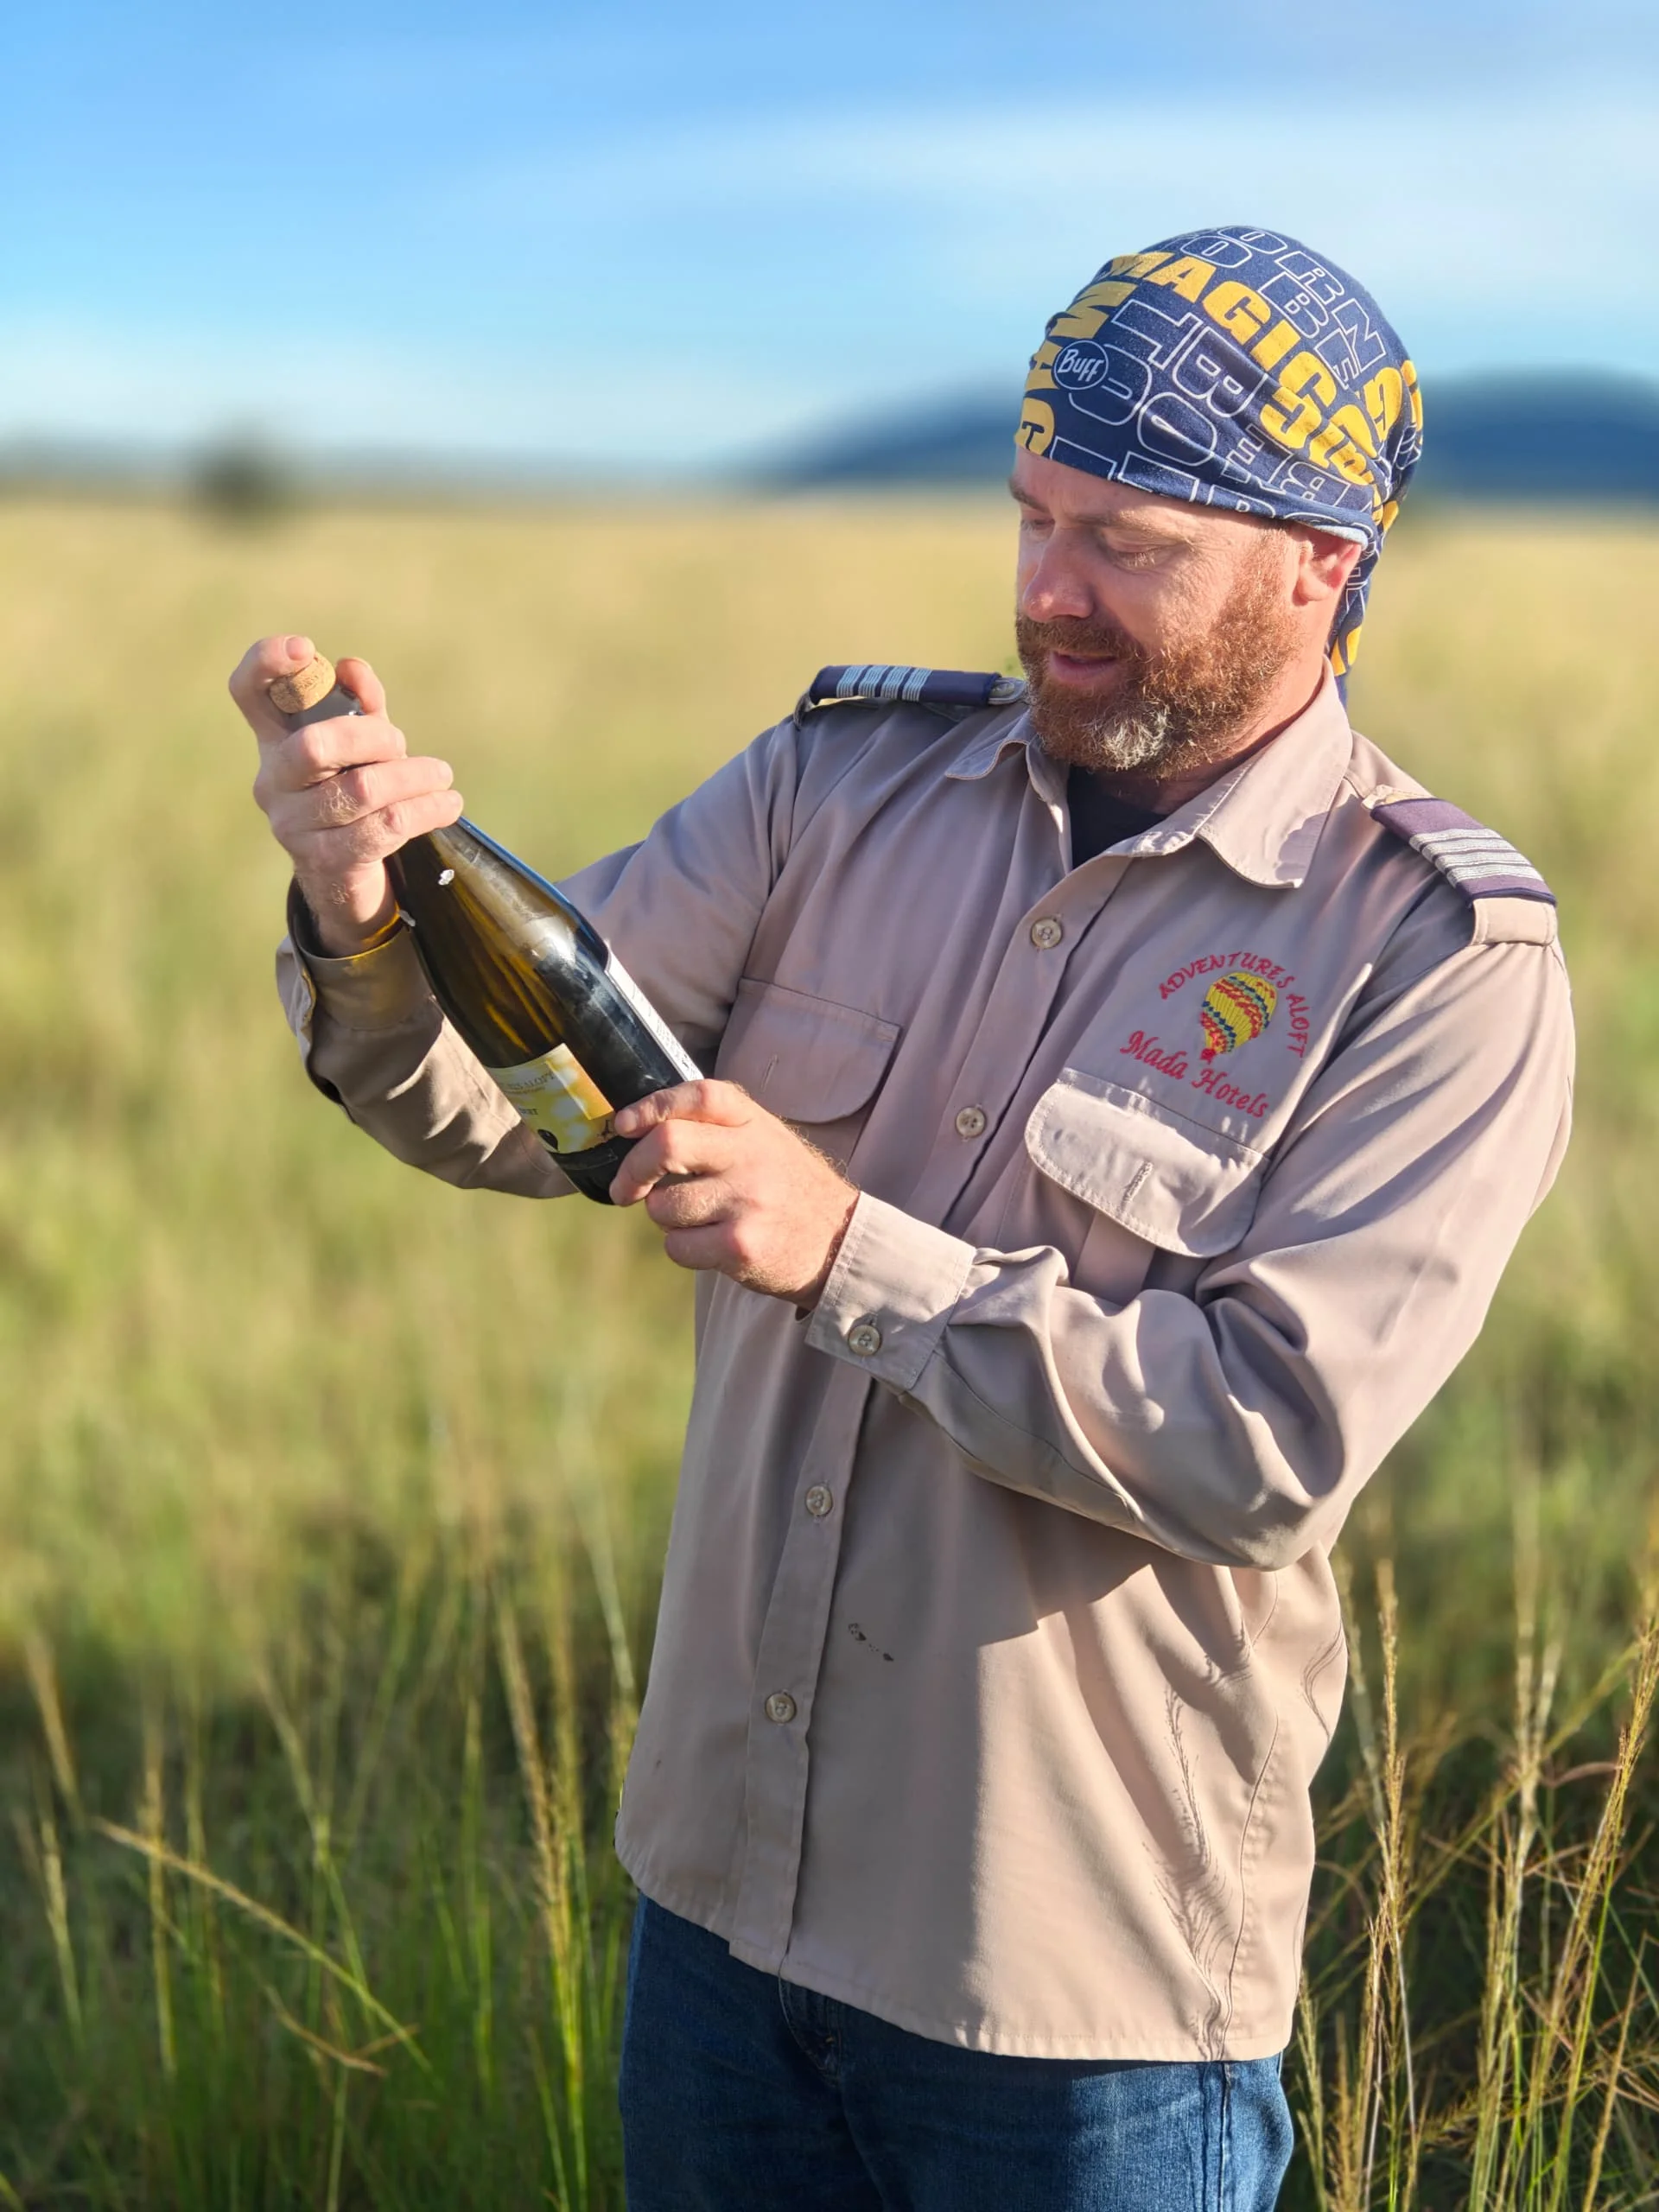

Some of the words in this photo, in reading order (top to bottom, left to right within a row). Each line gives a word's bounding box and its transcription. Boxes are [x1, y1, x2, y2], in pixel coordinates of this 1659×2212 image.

[1159, 951, 1295, 1001] ADVENTURES
[1286, 994, 1311, 1058] ALOFT
[1120, 1030, 1189, 1080] Mada
[1192, 1068, 1270, 1118] Hotels
